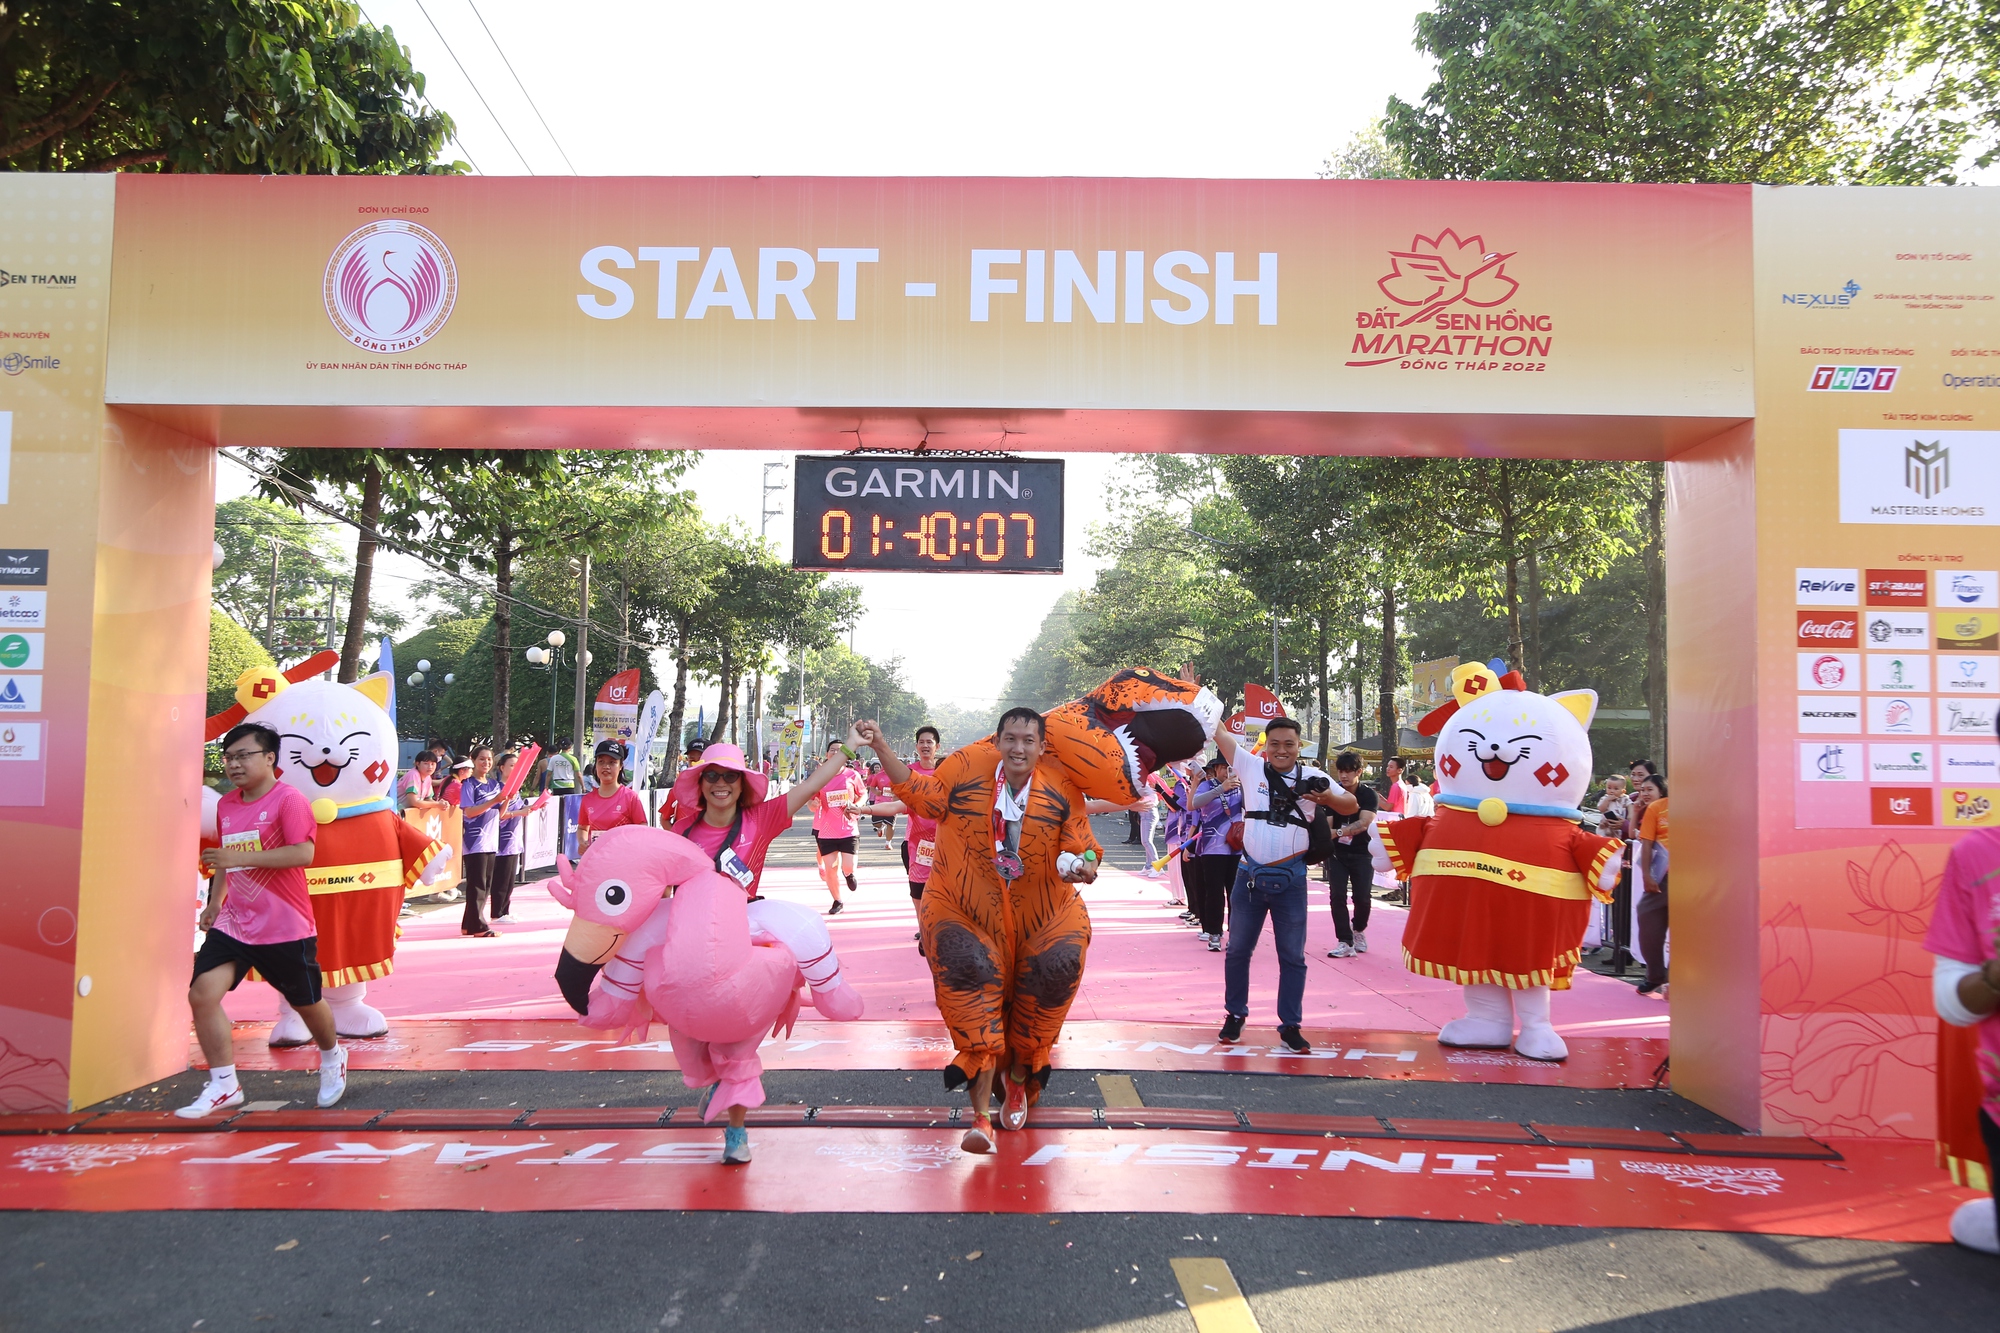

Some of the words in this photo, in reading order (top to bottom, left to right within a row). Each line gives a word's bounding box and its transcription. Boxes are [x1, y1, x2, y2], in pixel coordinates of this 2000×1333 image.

[358, 206, 378, 214] ĐƠN
[381, 206, 389, 215] VỊ
[392, 205, 407, 214] CHỈ
[409, 206, 429, 215] ĐẠO
[577, 245, 880, 321] START
[969, 248, 1278, 326] FINISH
[1782, 293, 1850, 309] NEXUS
[1356, 306, 1400, 329] ĐẤT
[1436, 313, 1481, 331] SEN
[1486, 309, 1552, 331] HỒNG
[354, 336, 387, 351] ĐỒNG
[391, 336, 421, 351] THÁP
[1351, 334, 1552, 357] MARATHON
[23, 355, 61, 369] Smile
[306, 360, 318, 370] ỦY
[320, 362, 339, 370] BAN
[341, 361, 368, 370] NHÂN
[369, 361, 389, 370] DÂN
[392, 360, 413, 370] TỈNH
[414, 360, 441, 370] ĐỒNG
[443, 361, 468, 370] THÁP
[1400, 358, 1448, 370] ĐỒNG
[1455, 359, 1498, 371] THÁP
[1502, 362, 1546, 372] 2022
[1816, 370, 1894, 388] THĐT
[1942, 373, 2000, 390] Operatio
[1871, 505, 1939, 516] MASTERISE
[1941, 506, 1985, 517] HOMES
[1799, 579, 1856, 593] ReVive
[0, 608, 39, 618] ietcoco
[1950, 680, 1986, 688] motive
[609, 685, 628, 699] lof
[1260, 700, 1278, 714] lof
[0, 745, 24, 753] ECTOR
[1873, 763, 1928, 771] Vietcombank
[1947, 758, 1996, 767] Sacombank
[1889, 797, 1911, 813] lof
[1955, 796, 1991, 820] MALTO
[226, 841, 256, 852] 213
[920, 846, 935, 857] 502
[306, 876, 354, 885] COMBANK
[445, 1040, 851, 1053] STAT
[1052, 1040, 1418, 1062] INISH
[1021, 1143, 1595, 1180] FINISH
